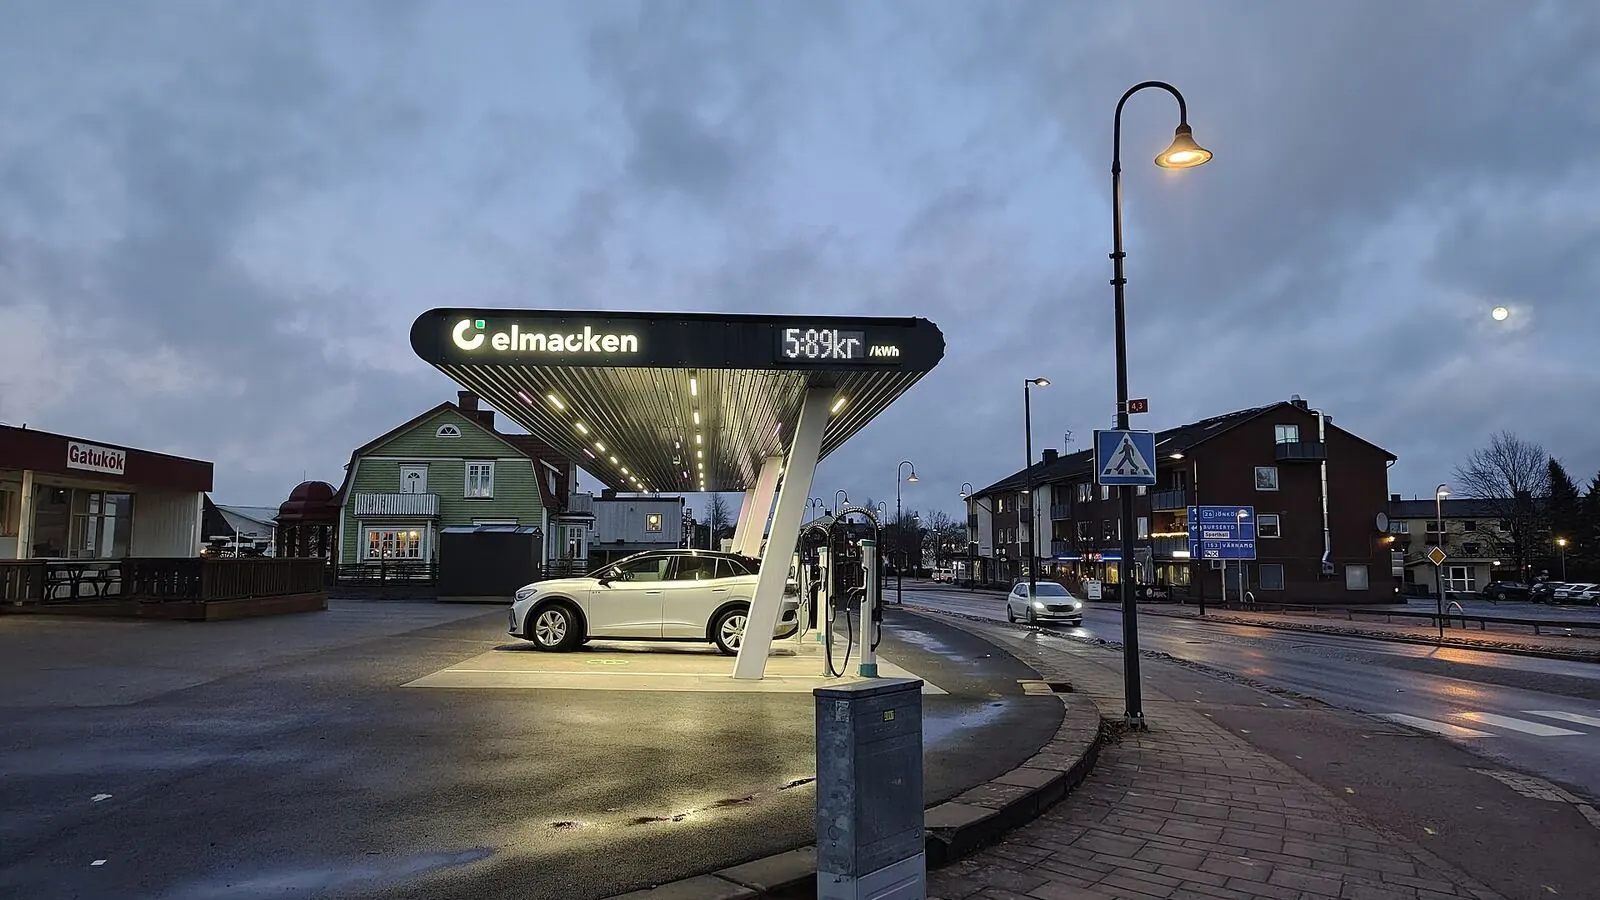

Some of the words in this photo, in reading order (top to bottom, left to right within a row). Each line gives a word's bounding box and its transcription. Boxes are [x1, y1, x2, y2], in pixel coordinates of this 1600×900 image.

[491, 325, 638, 352] elmacken
[868, 345, 900, 357] /kWh
[69, 444, 125, 470] Gatukök
